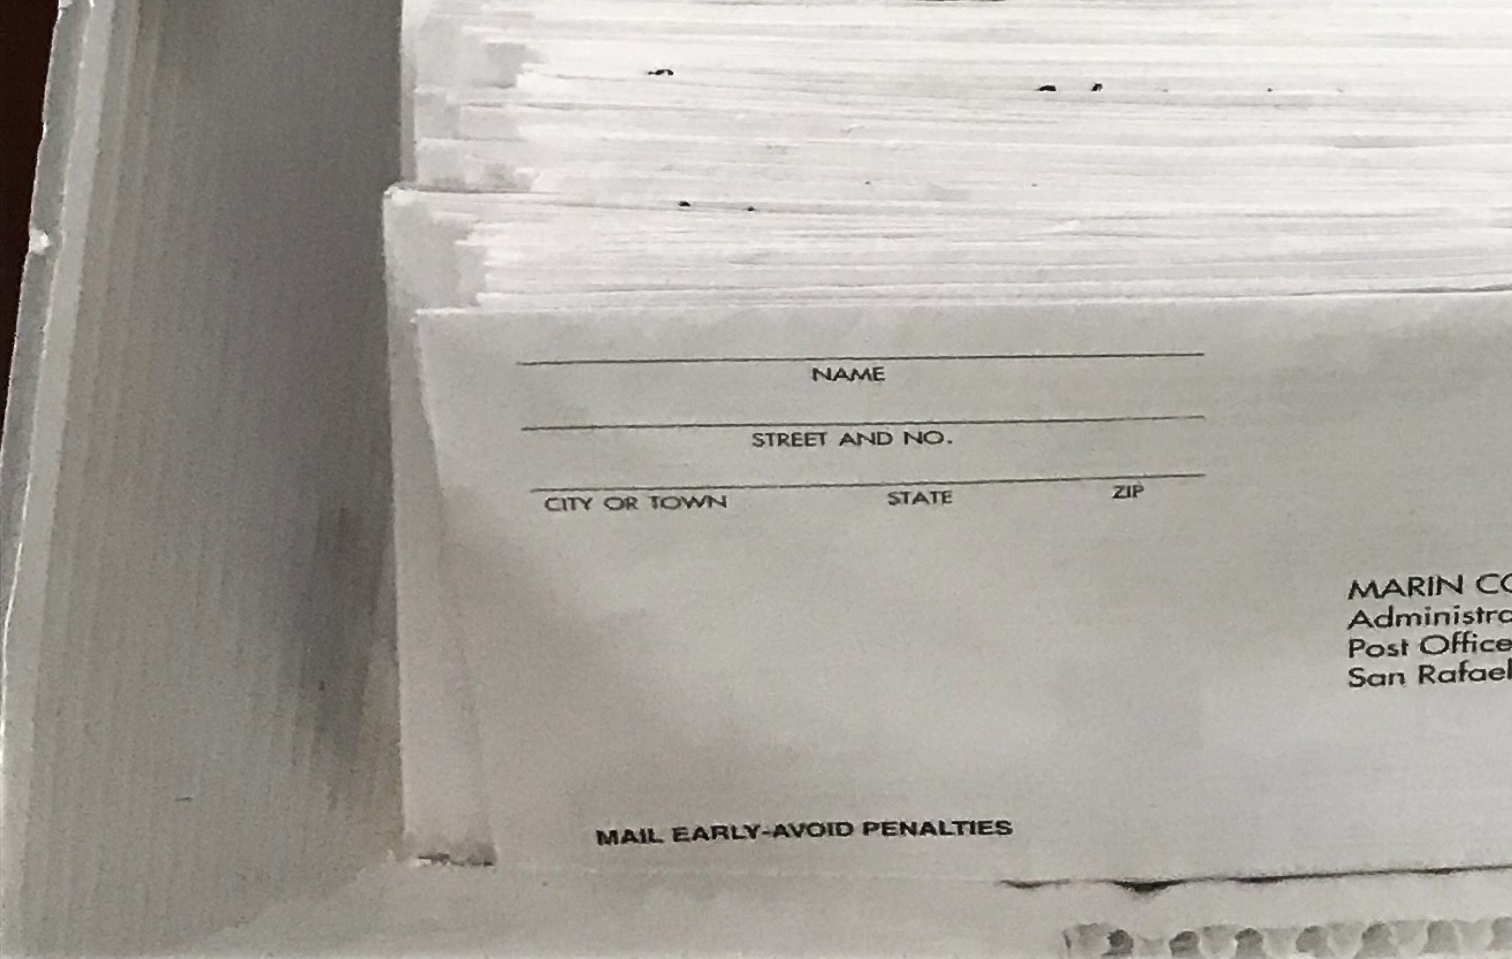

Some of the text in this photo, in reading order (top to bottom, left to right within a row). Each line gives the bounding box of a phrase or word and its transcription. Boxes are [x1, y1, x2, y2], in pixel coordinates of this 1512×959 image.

[811, 366, 886, 383] NAME
[751, 429, 954, 448] STREET AND NO.
[887, 489, 953, 506] STATE
[1111, 483, 1145, 499] ZIP
[545, 493, 728, 512] CITY OR TOWN
[1348, 573, 1465, 600] MARIN
[1347, 635, 1409, 659] Post
[1418, 630, 1512, 655] Office
[1347, 665, 1406, 688] San
[595, 819, 1014, 846] MAIL EARLY-AVOID PENALTIES
